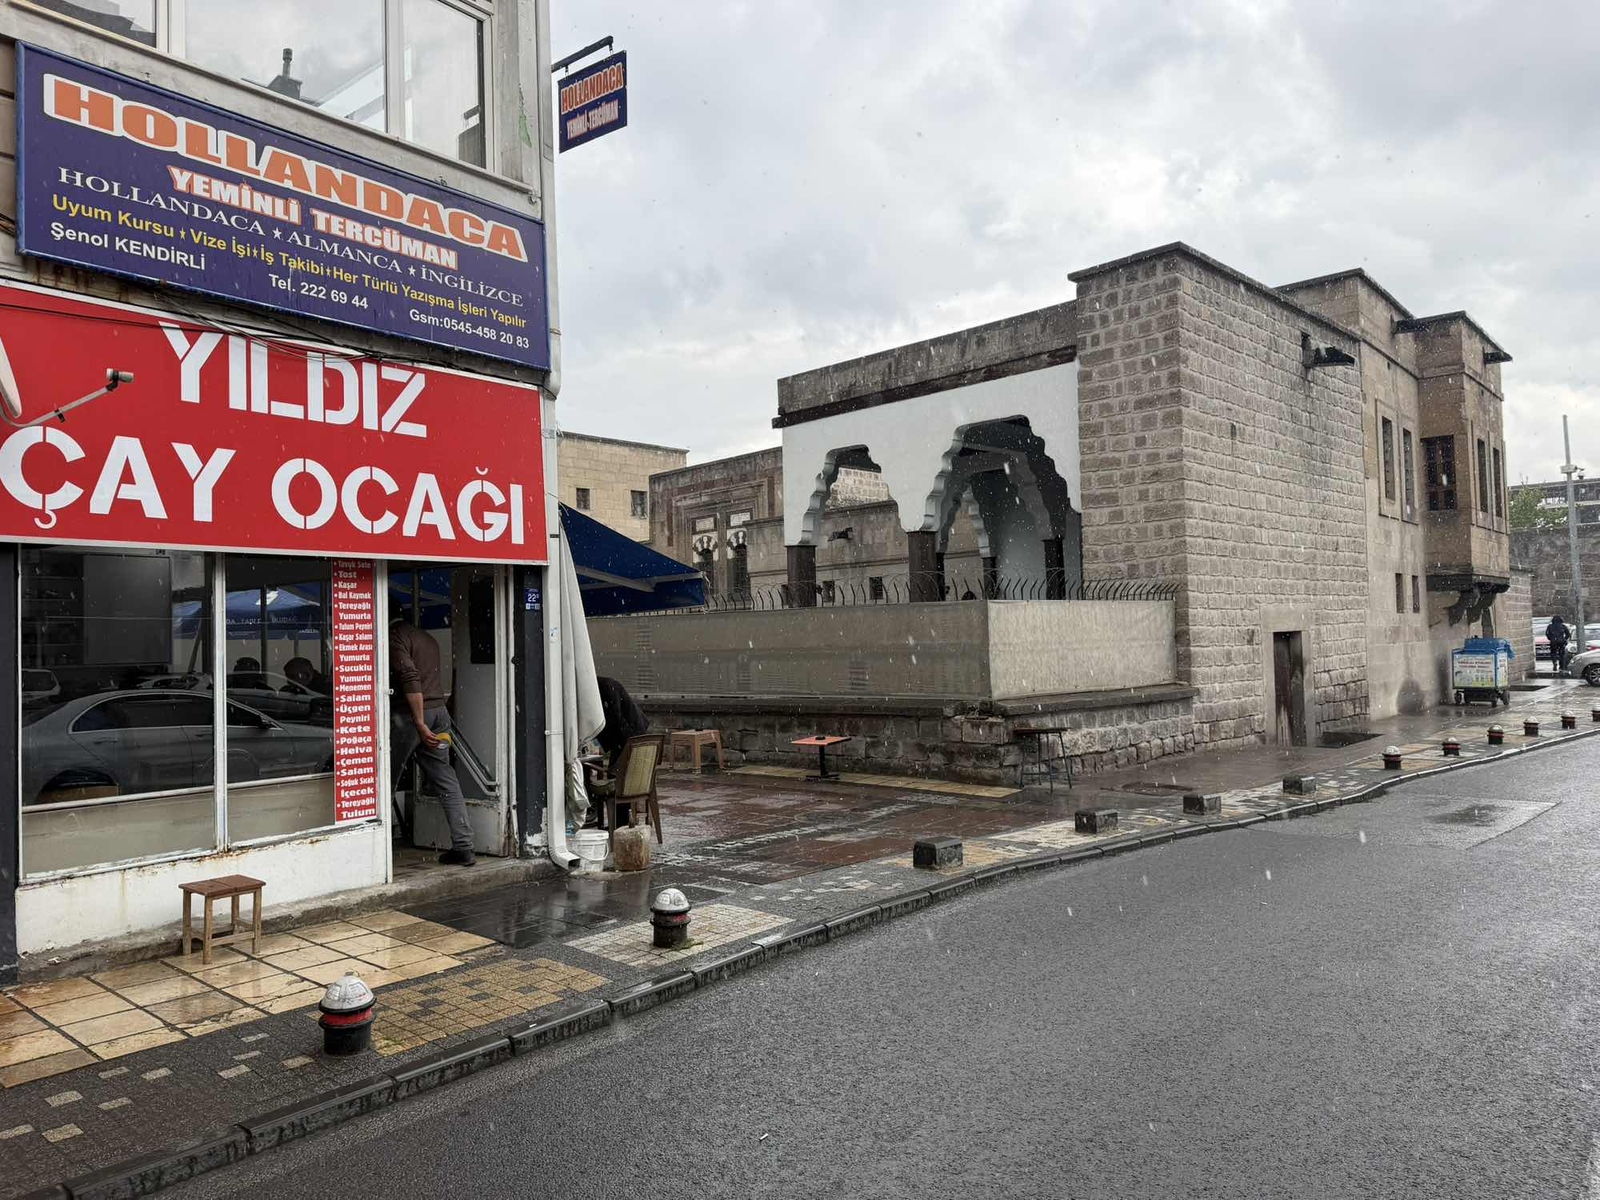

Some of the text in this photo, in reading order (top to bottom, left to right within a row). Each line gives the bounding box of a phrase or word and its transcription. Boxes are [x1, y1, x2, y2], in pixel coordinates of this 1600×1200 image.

[561, 62, 624, 114] HOLLANDACA
[43, 73, 528, 263] HOLLANDACA
[167, 165, 458, 270] YEMİNLİ TERCÜMAN
[58, 166, 524, 307] HOLLANDACA ALMANCA İNGİLİZCE
[50, 222, 206, 271] Şenol KENDİRLİ
[52, 193, 527, 329] Uyum Kursu Vize İşi İş Takibi Her Türlü Yazışma İşleri Yapılır
[268, 273, 369, 309] Tel. 222 69 44
[409, 309, 530, 349] Gsm:0545-458 20 83
[158, 321, 427, 438] YILDIZ
[0, 425, 525, 545] ÇAY OCAĞI
[338, 570, 357, 579] Tost
[338, 581, 357, 590] Kaşar
[339, 601, 371, 611] Tereyağlı
[339, 612, 372, 620] Yumurta
[339, 654, 371, 662] Yumurta
[339, 663, 373, 672] Sucuklu
[339, 674, 372, 682] Yumurta
[339, 684, 372, 692] Menemen
[340, 694, 371, 702] Salam
[340, 704, 371, 714] Üçgen
[340, 714, 371, 724] Peyniri
[340, 725, 371, 734] Kete
[340, 735, 372, 745] Poğaça
[340, 746, 373, 756] Helva
[340, 756, 373, 767] Çemen
[340, 767, 374, 776] Salam
[340, 786, 375, 799] İçecek
[341, 797, 375, 808] Tereyağlı
[341, 808, 376, 819] Tulum
